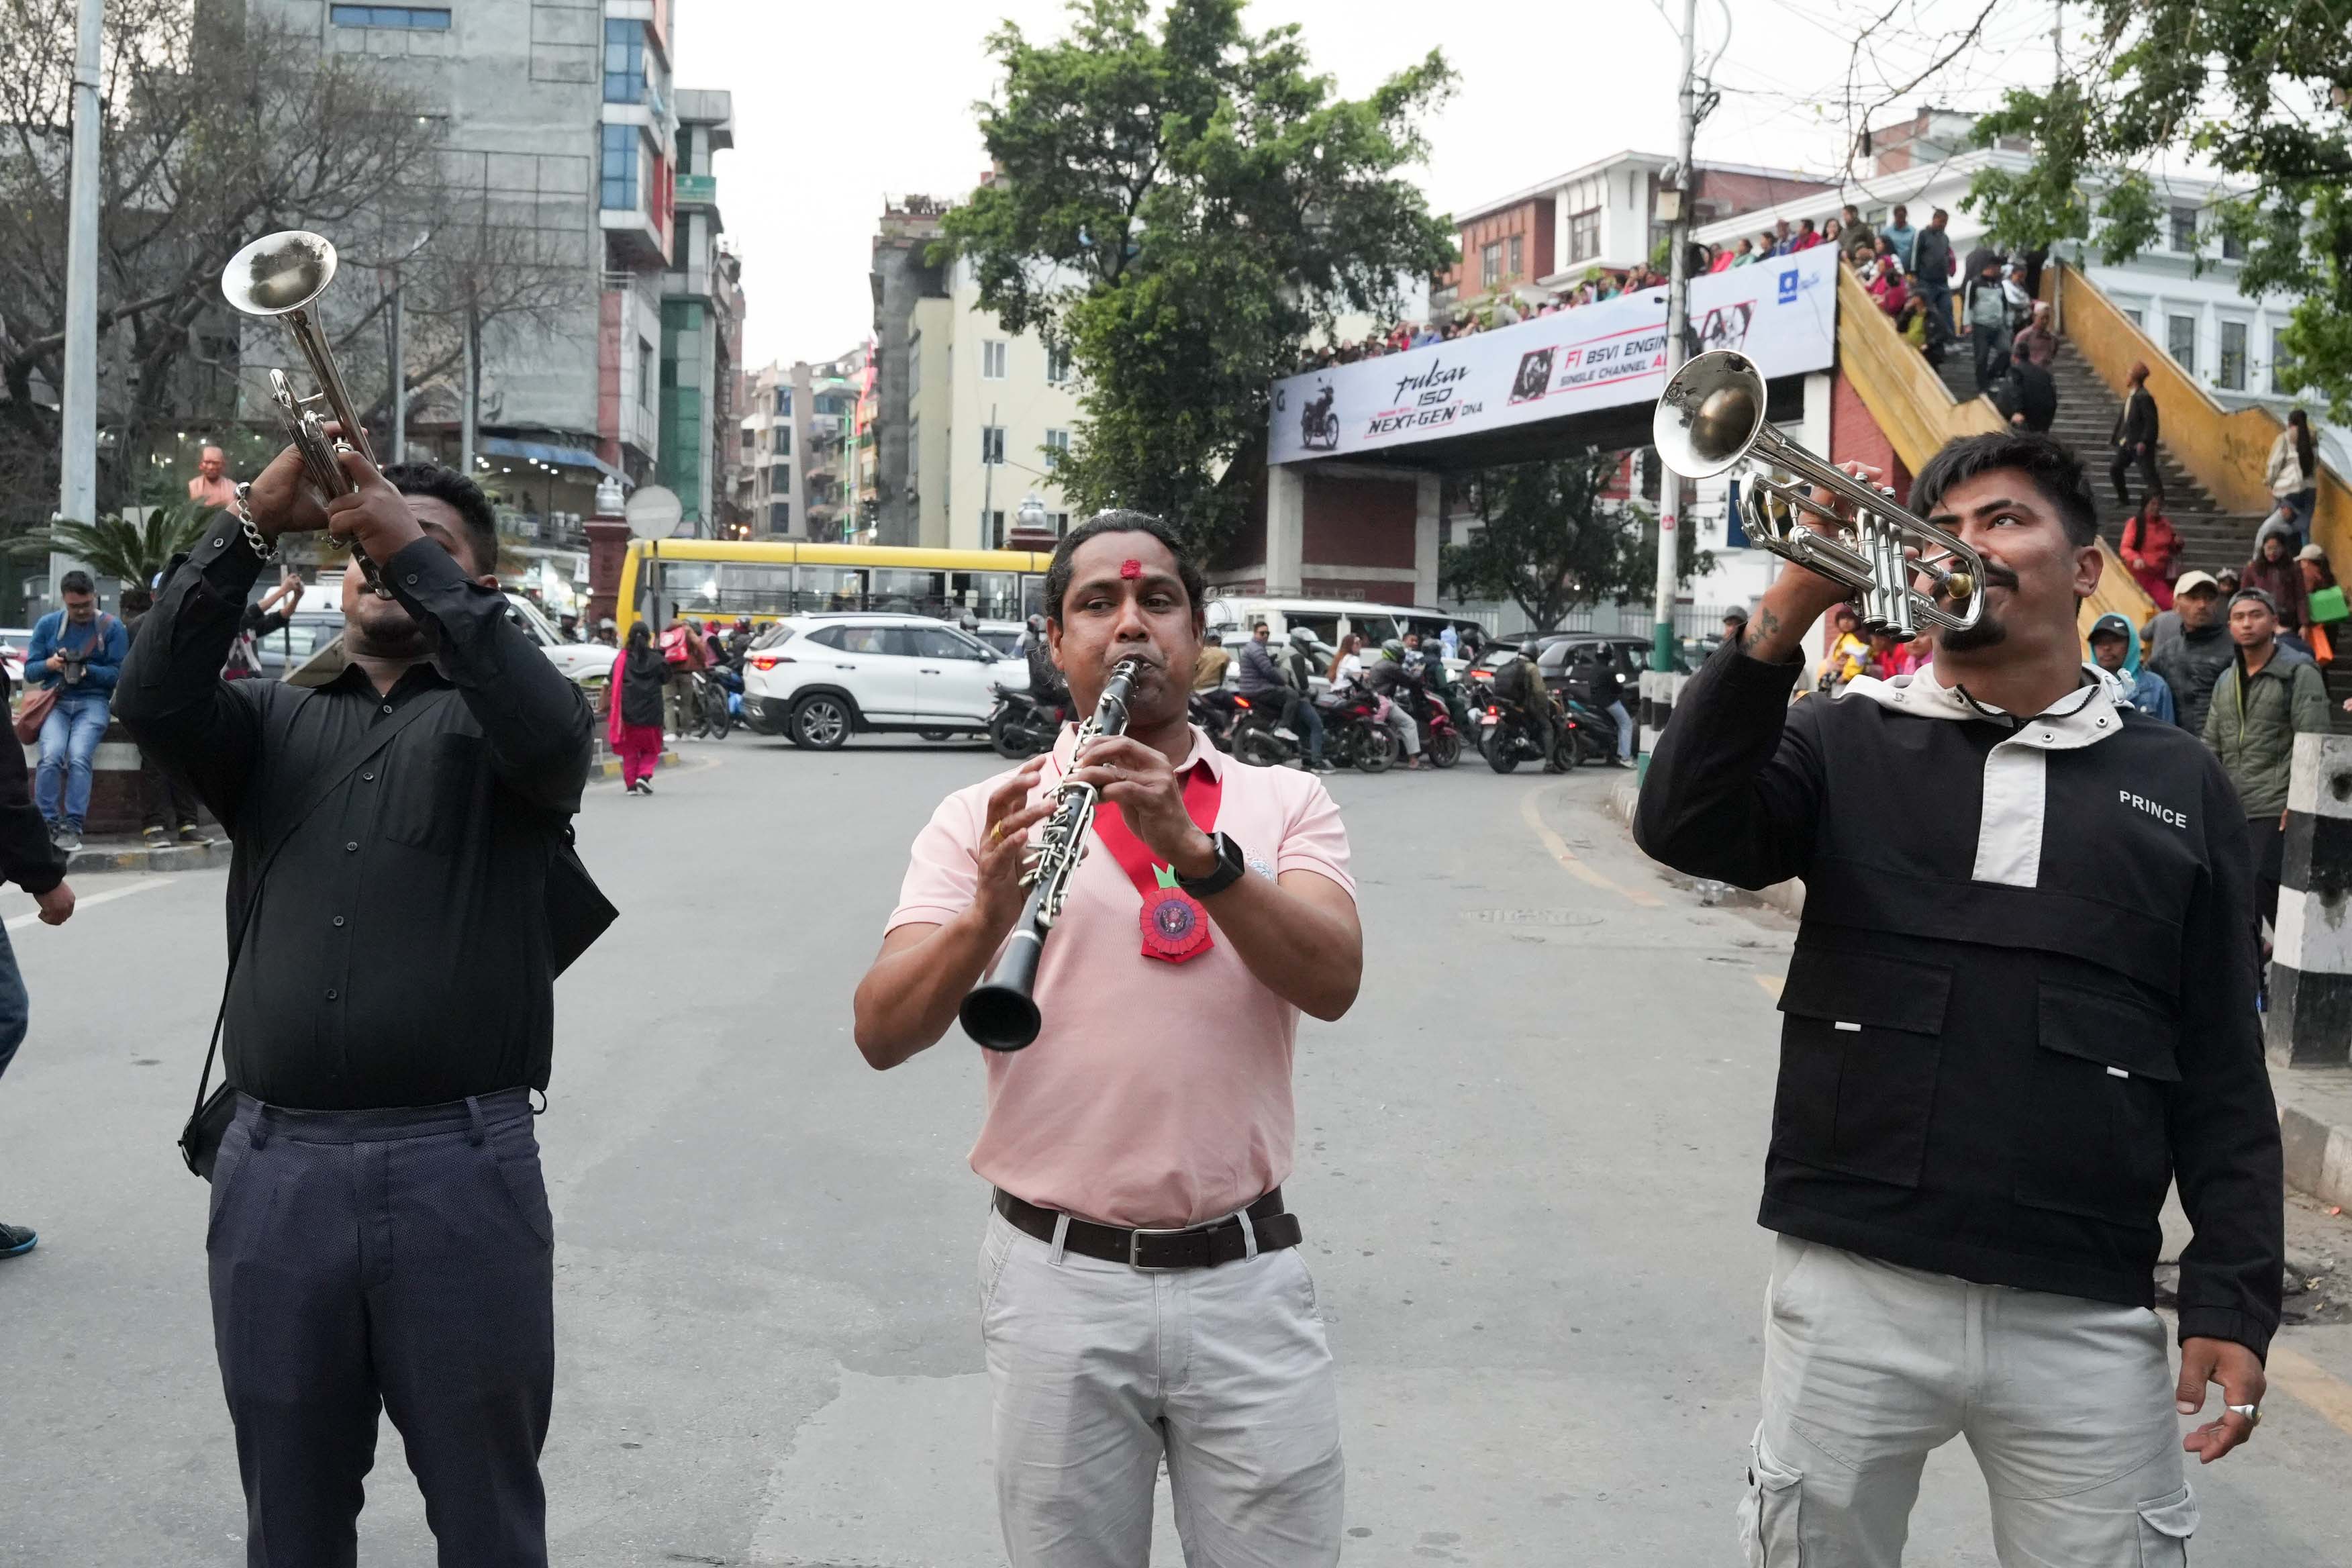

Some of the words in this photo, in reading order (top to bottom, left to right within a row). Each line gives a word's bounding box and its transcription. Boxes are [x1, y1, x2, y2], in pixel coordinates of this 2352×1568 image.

[1565, 349, 1583, 370] FI
[1585, 344, 1619, 364] BSVI
[1624, 335, 1667, 356] ENGIN
[1560, 370, 1595, 387] SINGLE
[1598, 360, 1647, 379] CHANNEL
[1417, 387, 1453, 407] 150
[1369, 405, 1456, 434] NEXT-GEN
[1461, 402, 1482, 417] DNA
[2119, 790, 2187, 828] PRINCE
